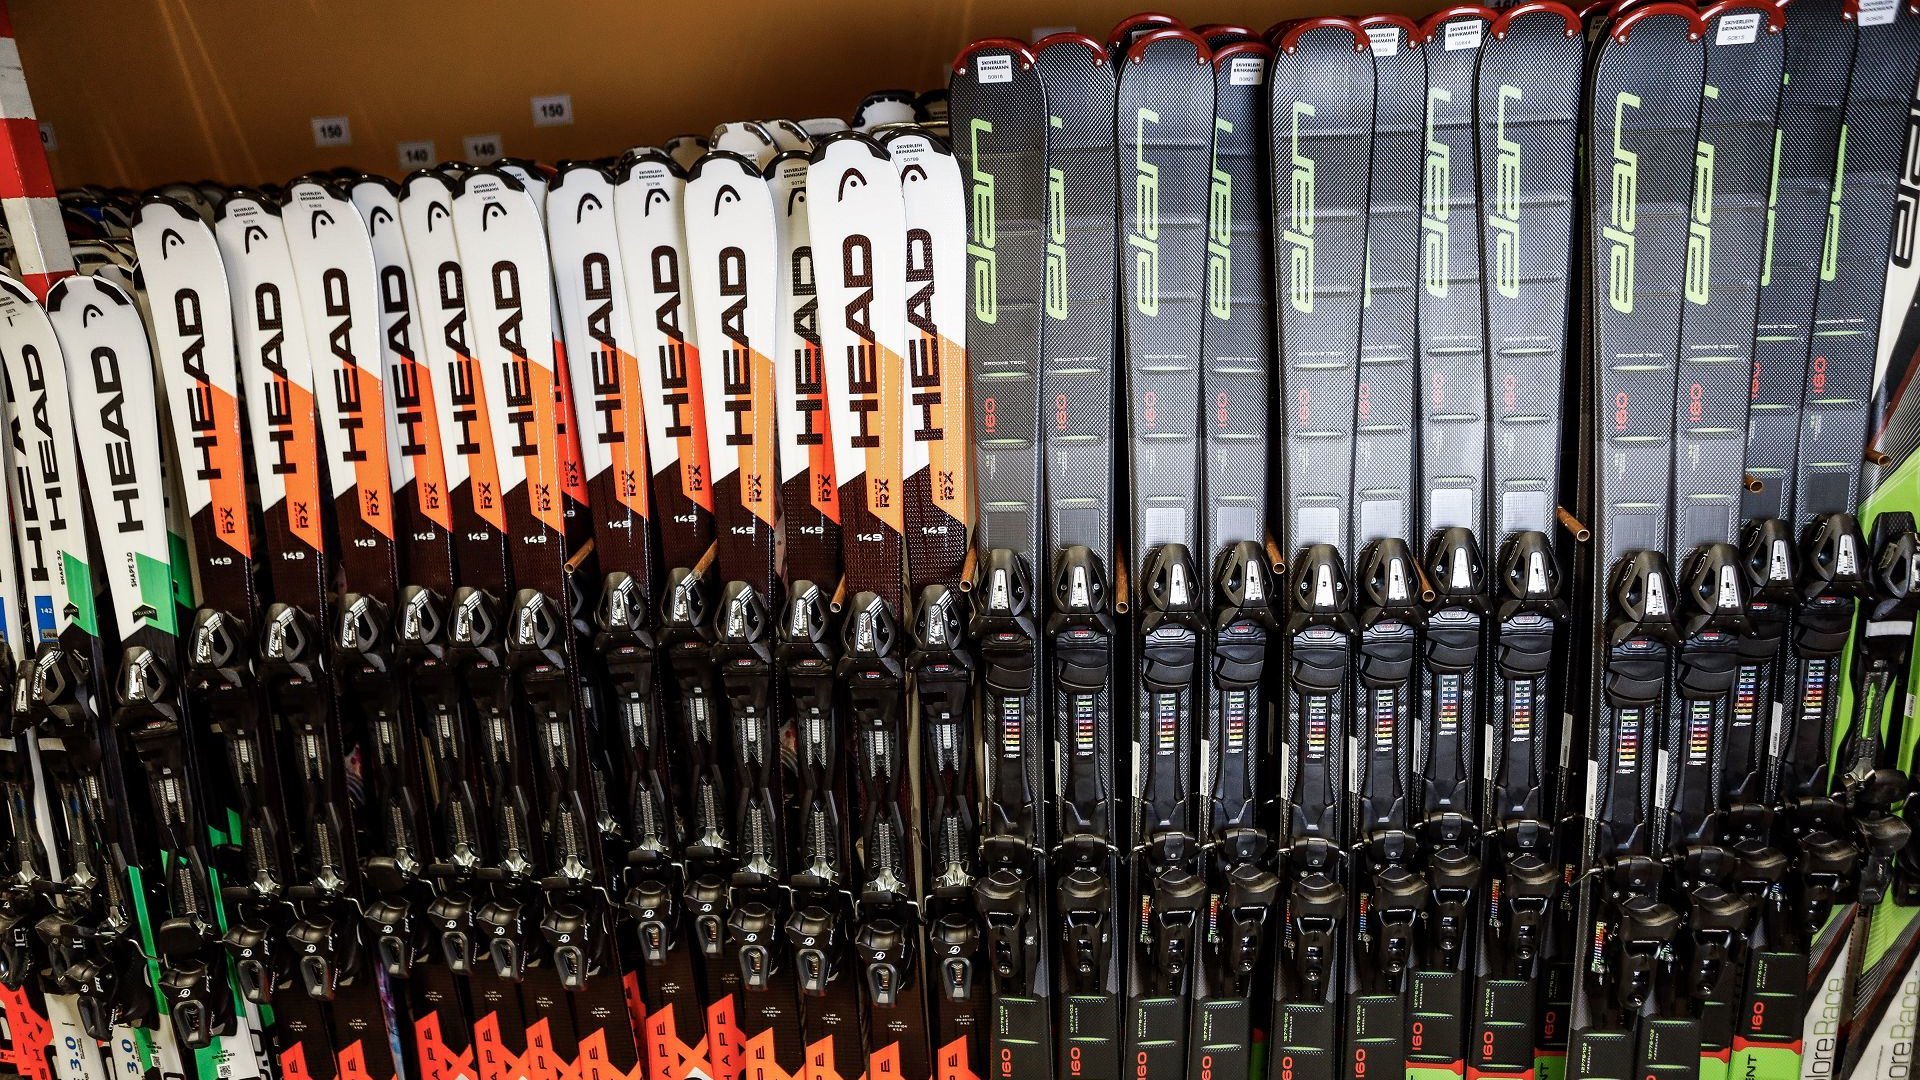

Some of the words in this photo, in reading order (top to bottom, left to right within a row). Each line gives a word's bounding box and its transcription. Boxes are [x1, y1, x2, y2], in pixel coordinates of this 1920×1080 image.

[1447, 30, 1480, 38] BRINKMANN
[1449, 24, 1478, 32] SKIVERLEIH
[1720, 24, 1756, 33] BRINKMANN
[1723, 17, 1754, 26] SKIVERLEIH
[541, 103, 564, 117] 150
[320, 125, 343, 139] 150
[406, 149, 428, 162] 140
[473, 143, 496, 156] 140
[1421, 86, 1450, 299] elan
[1489, 84, 1522, 299] elan
[1602, 91, 1641, 314] elan
[1128, 107, 1160, 318] elan
[1207, 117, 1233, 321] elan
[1284, 100, 1317, 314] elan
[967, 118, 997, 325] elan
[582, 252, 625, 444] HEAD
[651, 245, 692, 438] HEAD
[718, 246, 754, 446] HEAD
[791, 245, 823, 445] HEAD
[842, 233, 880, 448] HEAD
[905, 228, 944, 442] HEAD
[322, 267, 368, 462] HEAD
[380, 265, 426, 456] HEAD
[438, 261, 480, 455] HEAD
[491, 260, 539, 457] HEAD
[175, 288, 222, 480] HEAD
[255, 282, 298, 475] HEAD
[1812, 356, 1827, 393] 160
[985, 397, 996, 433] 160
[1055, 393, 1068, 430] 160
[1615, 392, 1628, 430] 160
[1689, 383, 1703, 422] 160
[22, 344, 67, 531] HEAD
[90, 346, 145, 533] HEAD
[568, 461, 579, 487] RX
[626, 470, 637, 497] RX
[692, 464, 703, 491] RX
[752, 474, 763, 502] RX
[821, 474, 832, 502] RX
[943, 471, 955, 500] RX
[369, 489, 380, 516] RX
[428, 482, 439, 509] RX
[482, 482, 493, 509] RX
[540, 484, 551, 511] RX
[879, 479, 890, 507] RX
[224, 507, 236, 534] RX
[298, 502, 309, 528] RX
[608, 520, 631, 529] 149
[673, 514, 698, 523] 149
[353, 538, 377, 548] 149
[413, 532, 436, 542] 149
[467, 532, 489, 542] 149
[523, 535, 547, 545] 149
[730, 526, 755, 535] 149
[800, 526, 824, 535] 149
[856, 533, 882, 542] 149
[921, 526, 947, 535] 149
[126, 551, 134, 562] 3.0
[209, 556, 232, 566] 149
[282, 551, 305, 562] 149
[58, 560, 66, 586] SHAPE
[127, 563, 138, 588] SHAPE
[1544, 1011, 1556, 1039] 160
[1752, 1002, 1765, 1031] 160
[1412, 1022, 1423, 1051] 160
[1483, 1031, 1494, 1060] 160
[65, 1036, 82, 1072] 3.0
[121, 1038, 138, 1075] 3.0
[1001, 1048, 1012, 1078] 160
[1070, 1047, 1081, 1076] 160
[1137, 1052, 1147, 1080] 160
[1202, 1056, 1212, 1080] 60
[1282, 1056, 1293, 1080] 60
[1355, 1049, 1366, 1078] 160
